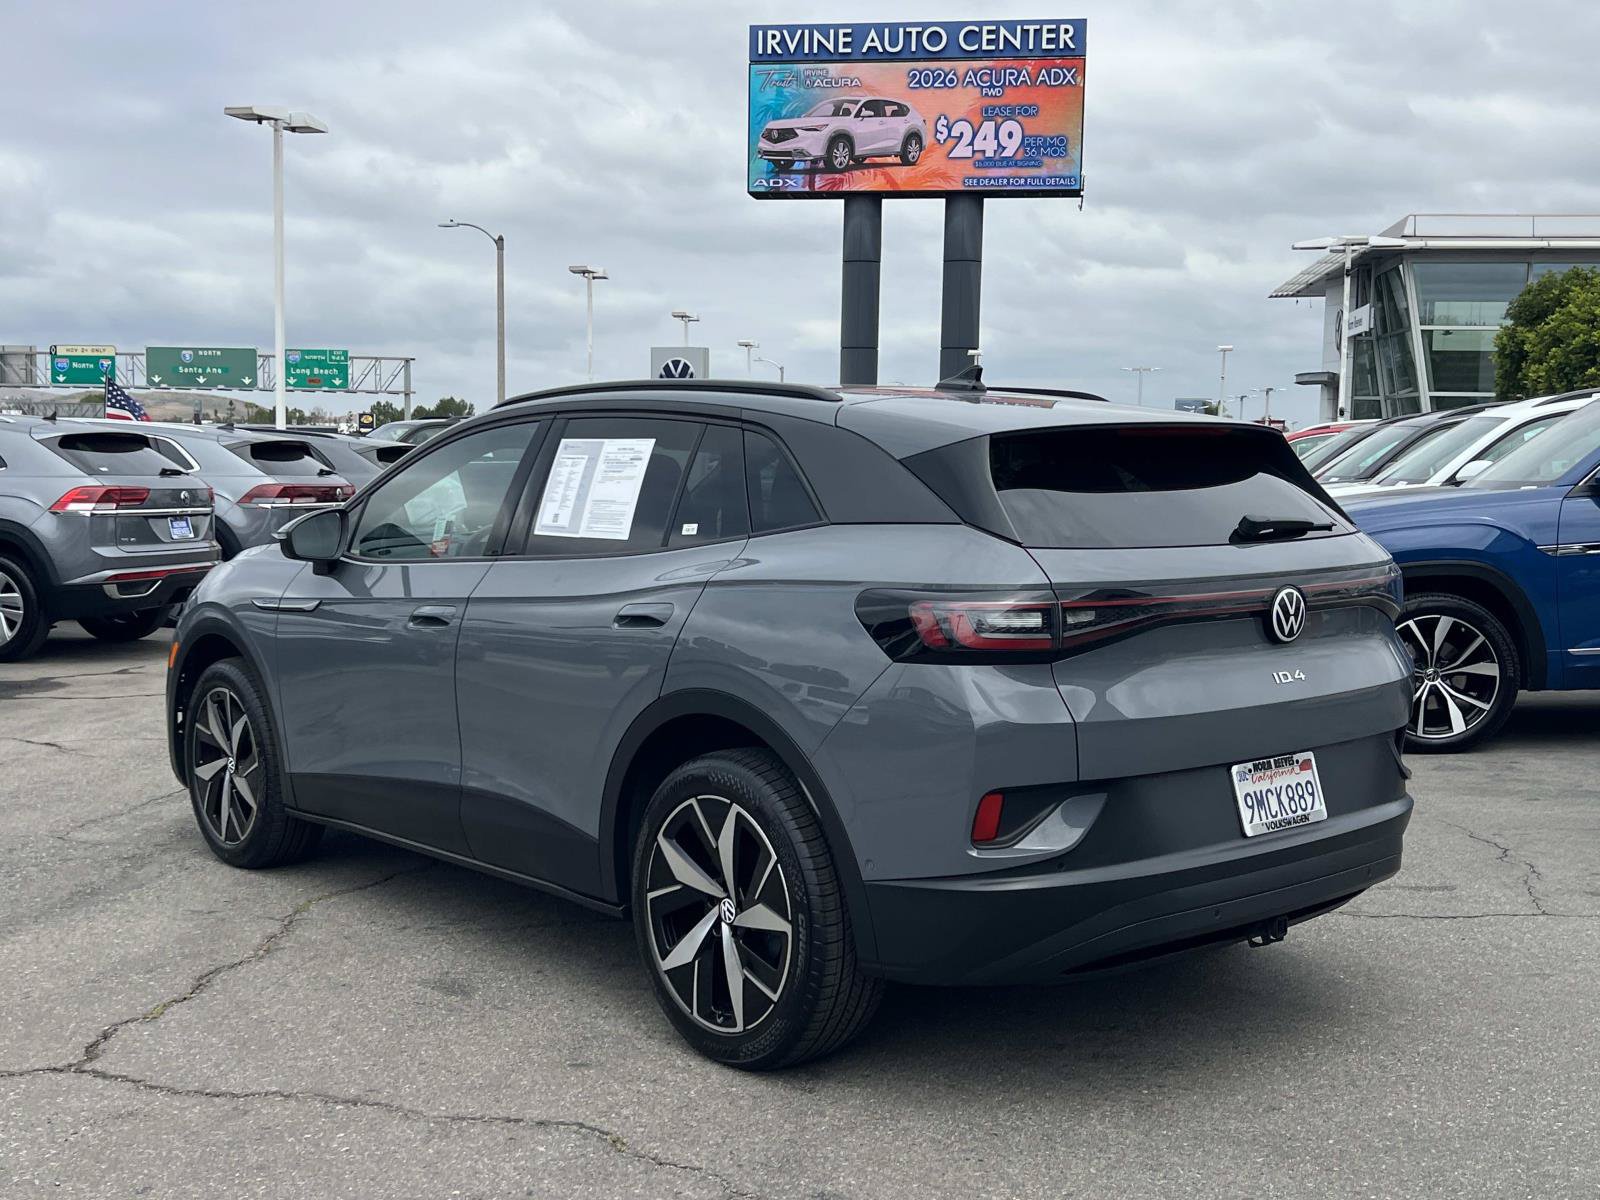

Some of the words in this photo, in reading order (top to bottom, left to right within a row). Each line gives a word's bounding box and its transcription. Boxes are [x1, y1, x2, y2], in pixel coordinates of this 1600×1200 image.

[757, 28, 853, 55] IRVINE
[861, 26, 948, 53] AUTO
[958, 24, 1076, 52] CENTER
[804, 68, 828, 76] IRVINE
[756, 69, 796, 92] Trust
[814, 78, 862, 88] ACURA
[909, 70, 958, 88] 2026
[963, 68, 1031, 87] ACURA
[1036, 68, 1077, 86] ADX
[982, 88, 1003, 97] FWD
[982, 106, 1012, 117] LEASE
[1015, 106, 1038, 116] FOR
[935, 115, 1023, 158] $249
[1024, 137, 1043, 147] PER
[1046, 136, 1067, 147] MO
[1024, 147, 1037, 157] 36
[1040, 147, 1066, 157] MOS
[753, 178, 798, 187] ADX
[964, 178, 977, 186] SEE
[979, 178, 1007, 186] DEALER
[1027, 177, 1043, 185] FULL
[1045, 177, 1075, 185] DETAILS
[178, 366, 203, 374] Santa
[206, 366, 222, 374] Ana
[290, 367, 310, 375] Long
[313, 367, 339, 375] Beach
[1252, 760, 1273, 773] NORM
[1273, 757, 1295, 769] REEVES
[1251, 767, 1300, 785] California
[1244, 780, 1315, 824] 9MCK889
[1265, 814, 1311, 831] VOLKSWAGEN
